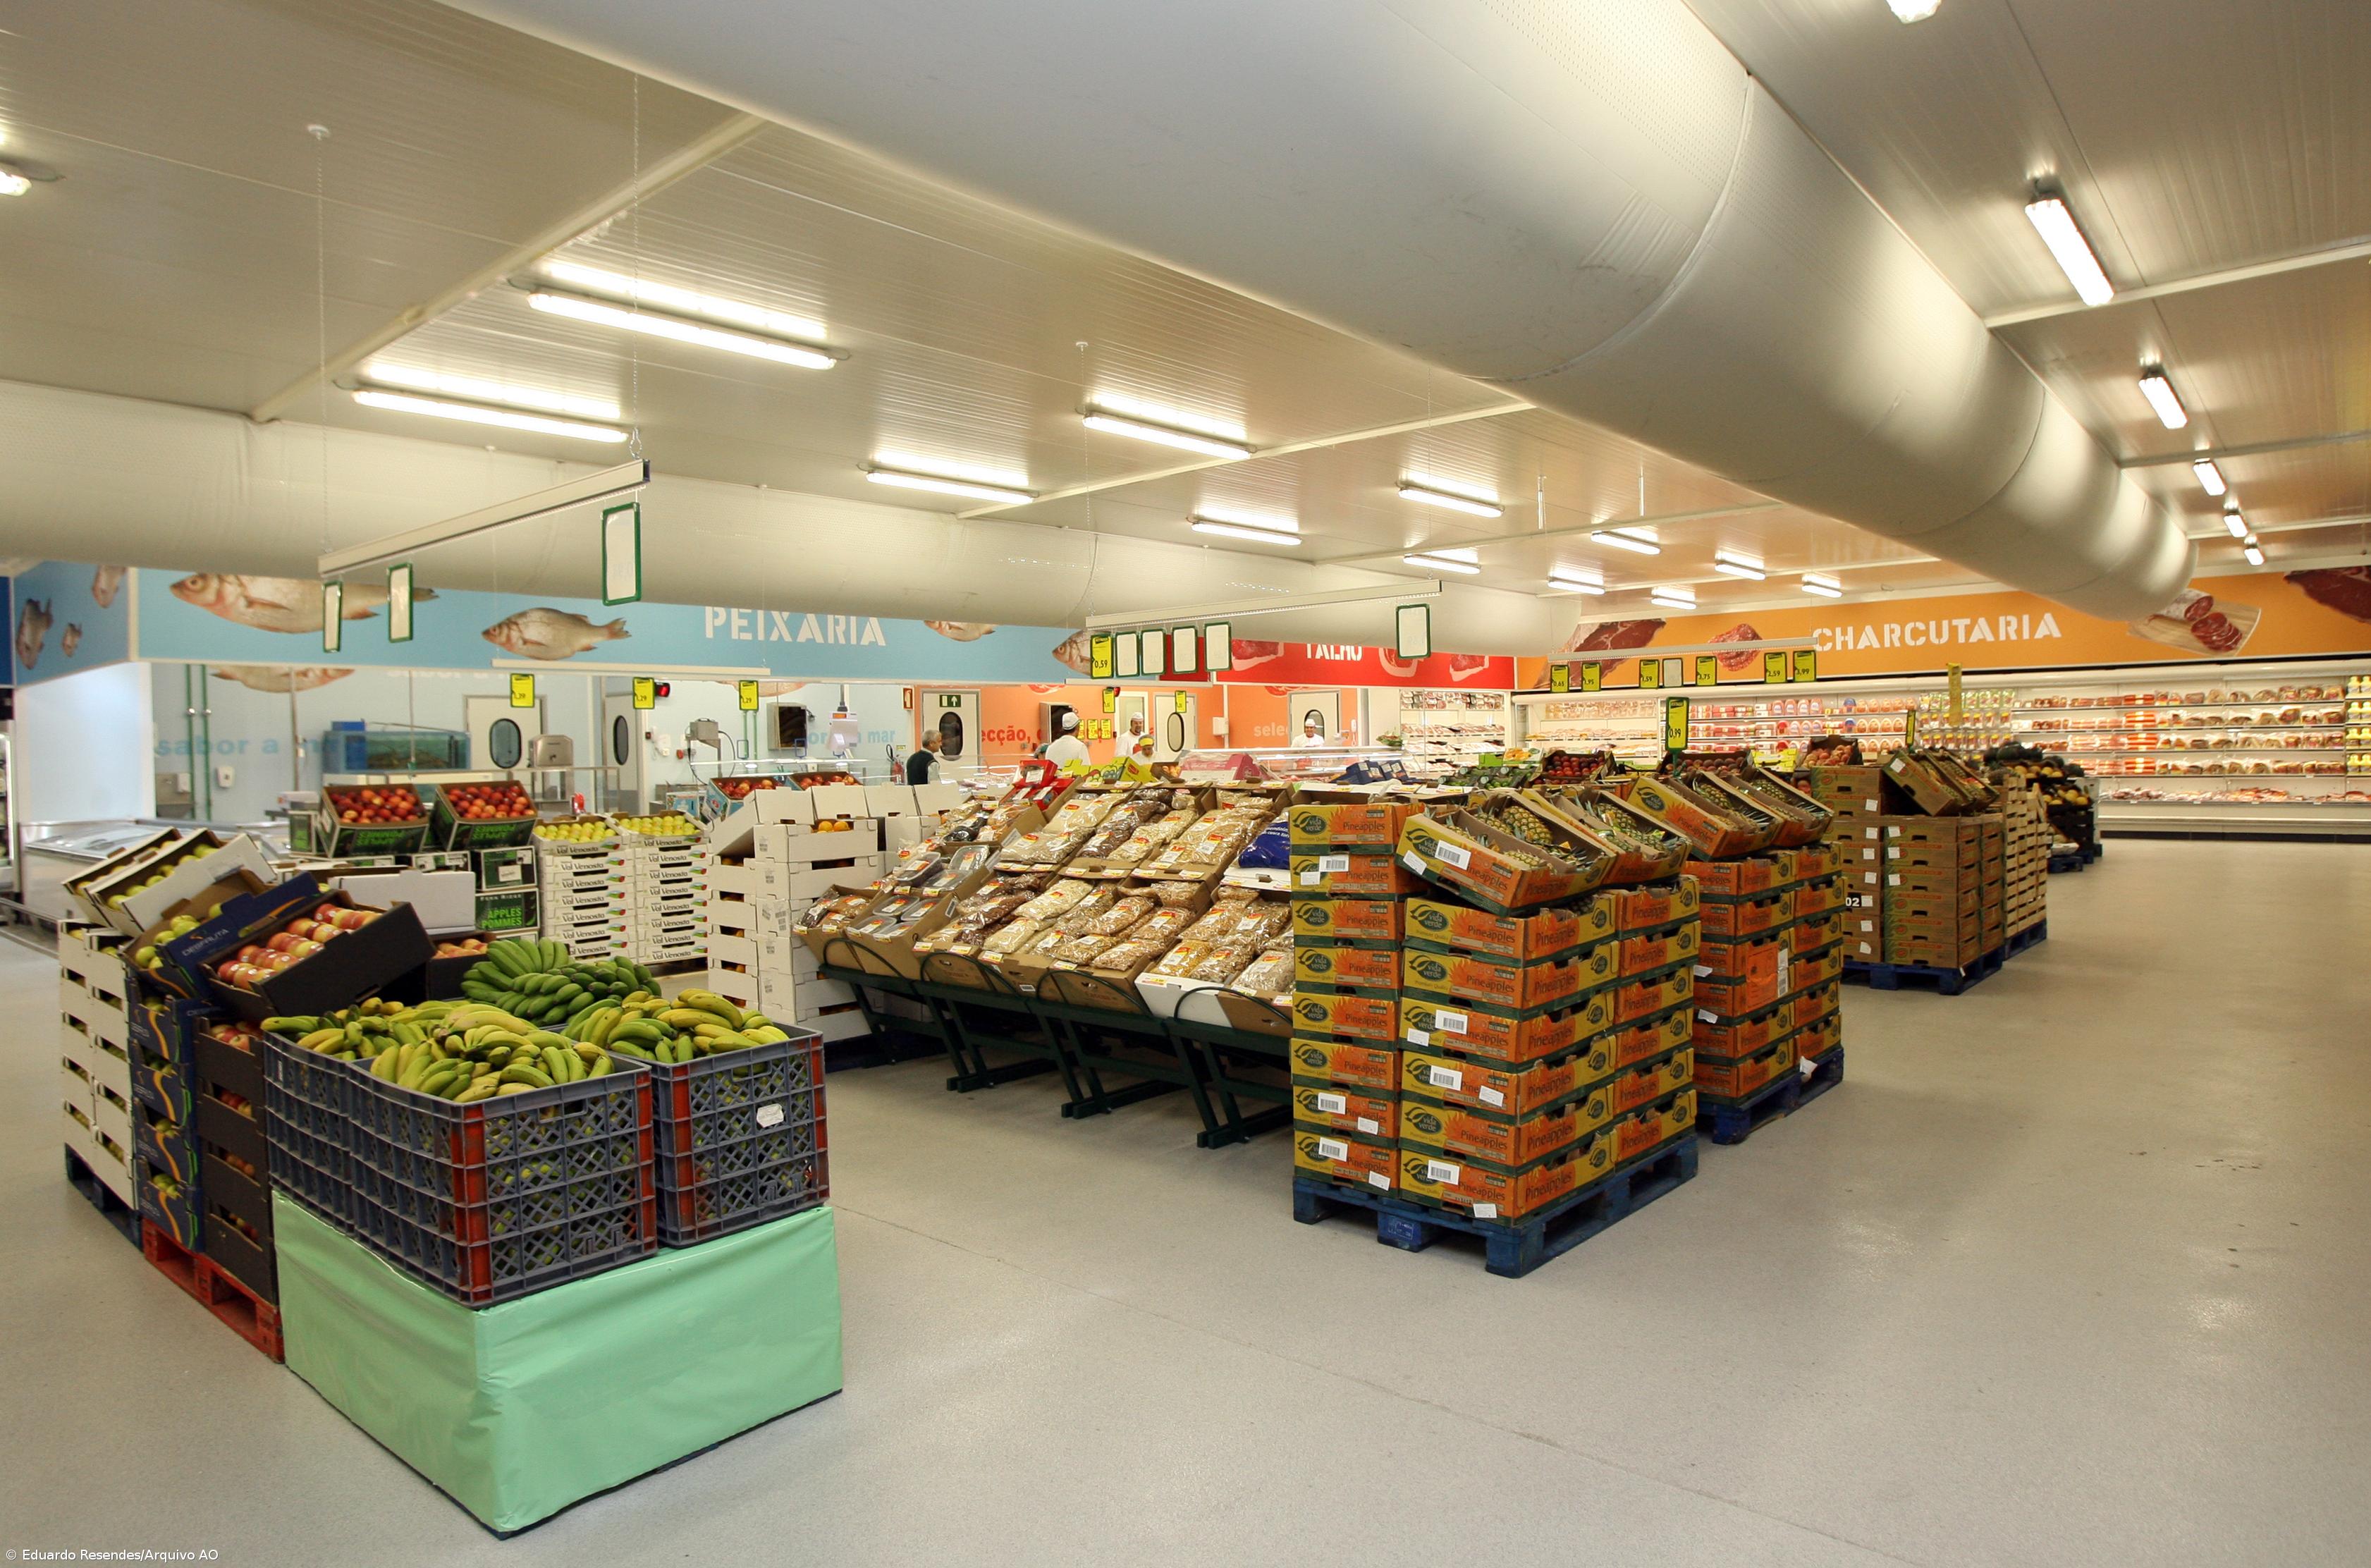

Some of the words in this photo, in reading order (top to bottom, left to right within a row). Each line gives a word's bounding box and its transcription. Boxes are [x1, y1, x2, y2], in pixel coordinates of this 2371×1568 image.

[706, 606, 886, 646] PEIXARIA
[1813, 613, 2061, 652] CHARCUTARIA
[1094, 659, 1108, 669] 0,59
[868, 730, 895, 743] mar
[1343, 821, 1385, 833] Pineapples
[1347, 871, 1389, 883] Pineapples
[1468, 864, 1508, 890] ineapples
[1845, 897, 1860, 907] 02
[488, 907, 522, 919] APPLES
[1347, 916, 1388, 927] Pineapples
[1468, 925, 1515, 943] Pineapples
[1349, 963, 1391, 976] Pineapples
[1466, 975, 1515, 993] Pineapples
[1346, 1013, 1388, 1027] Pineapples
[1460, 1031, 1509, 1048] ineapples
[1344, 1060, 1387, 1075] Pineapples
[1461, 1129, 1507, 1150] Pineapples
[1347, 1157, 1389, 1173] Pineapples
[1459, 1182, 1506, 1201] Pineapples
